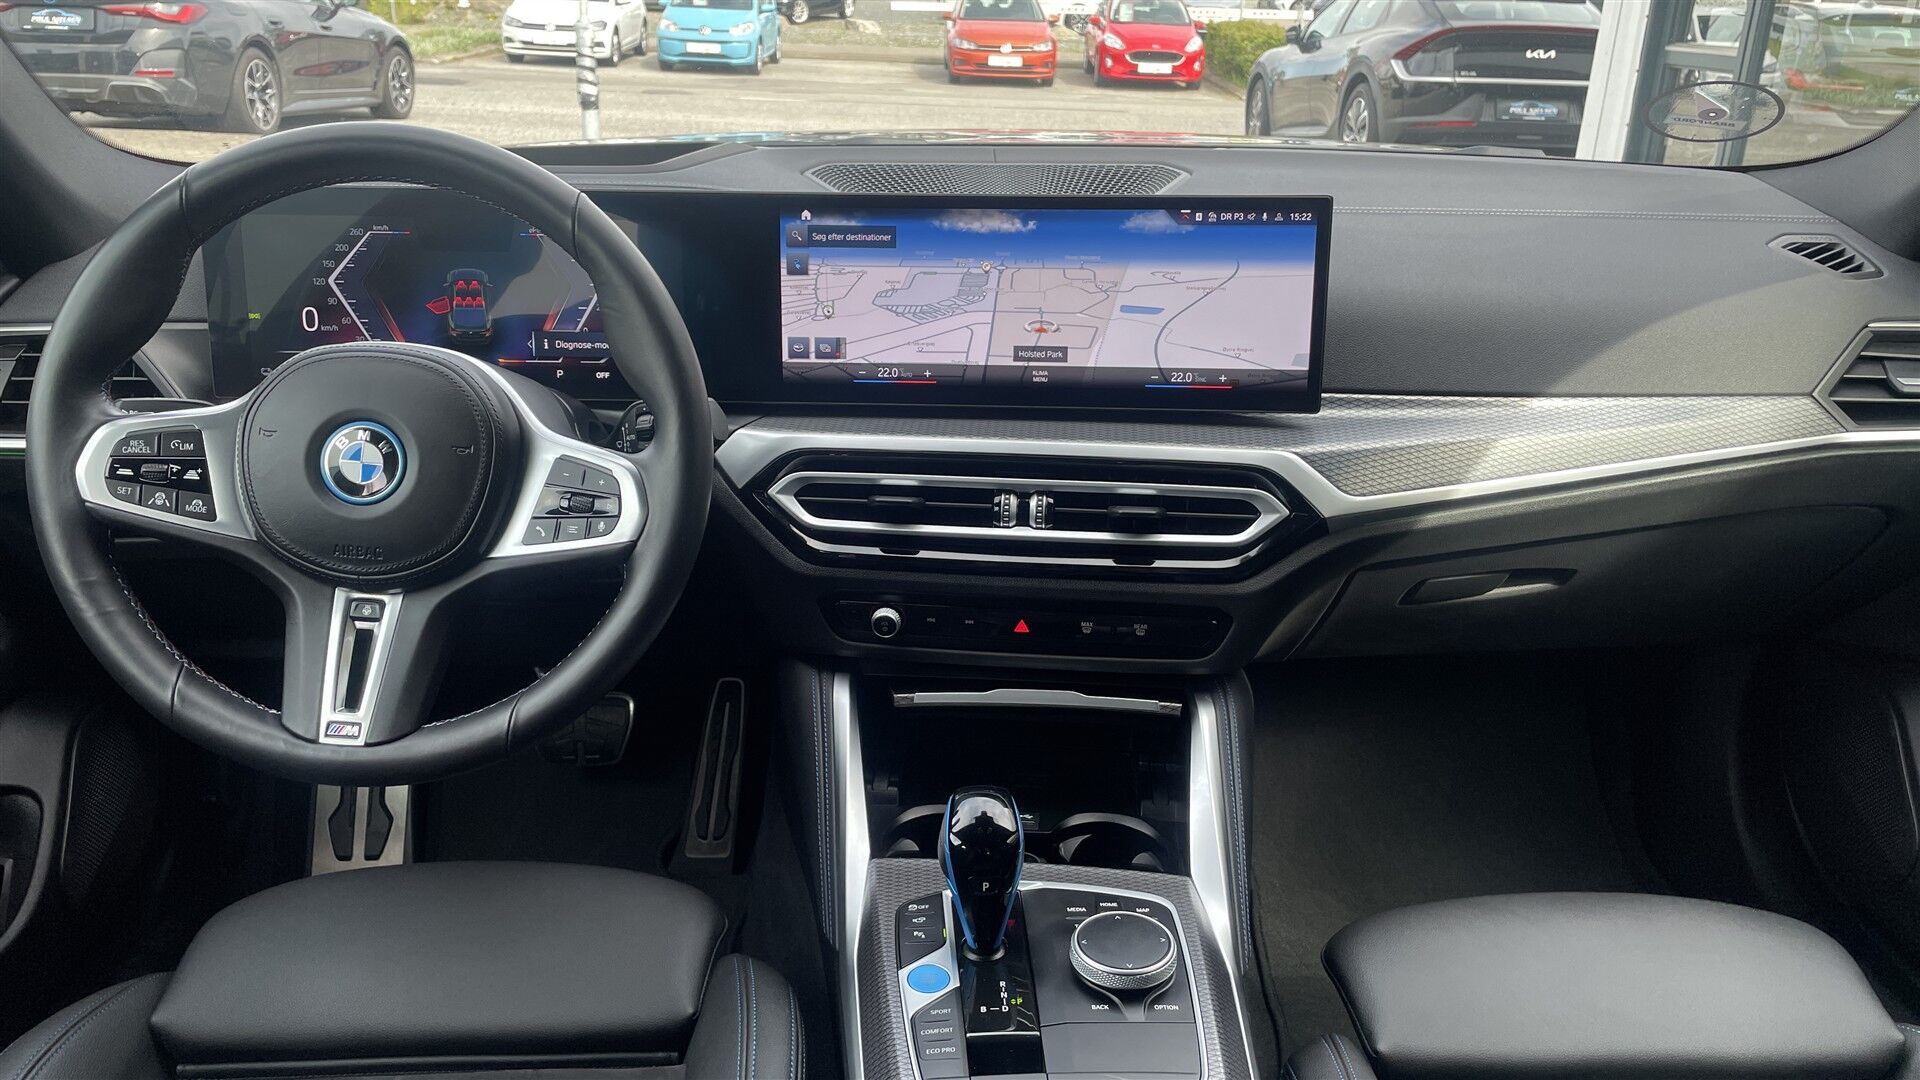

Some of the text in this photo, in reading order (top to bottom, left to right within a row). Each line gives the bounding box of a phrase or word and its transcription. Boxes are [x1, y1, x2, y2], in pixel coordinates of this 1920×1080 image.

[350, 228, 364, 236] 260
[812, 232, 892, 241] Søg efter destinationer
[323, 260, 335, 268] 150
[302, 306, 319, 332] 0
[342, 317, 351, 325] 60
[1018, 350, 1063, 358] Holsted Park
[556, 370, 564, 379] P
[877, 367, 899, 378] 22.0
[1170, 372, 1192, 382] 22.0
[129, 440, 145, 448] RES
[335, 430, 393, 454] BMW
[122, 446, 151, 454] CANCEL
[117, 487, 133, 495] SET
[185, 504, 208, 513] MODE
[982, 881, 990, 892] P
[999, 980, 1006, 988] R
[980, 1005, 987, 1013] B
[920, 1027, 954, 1035] COMFORT
